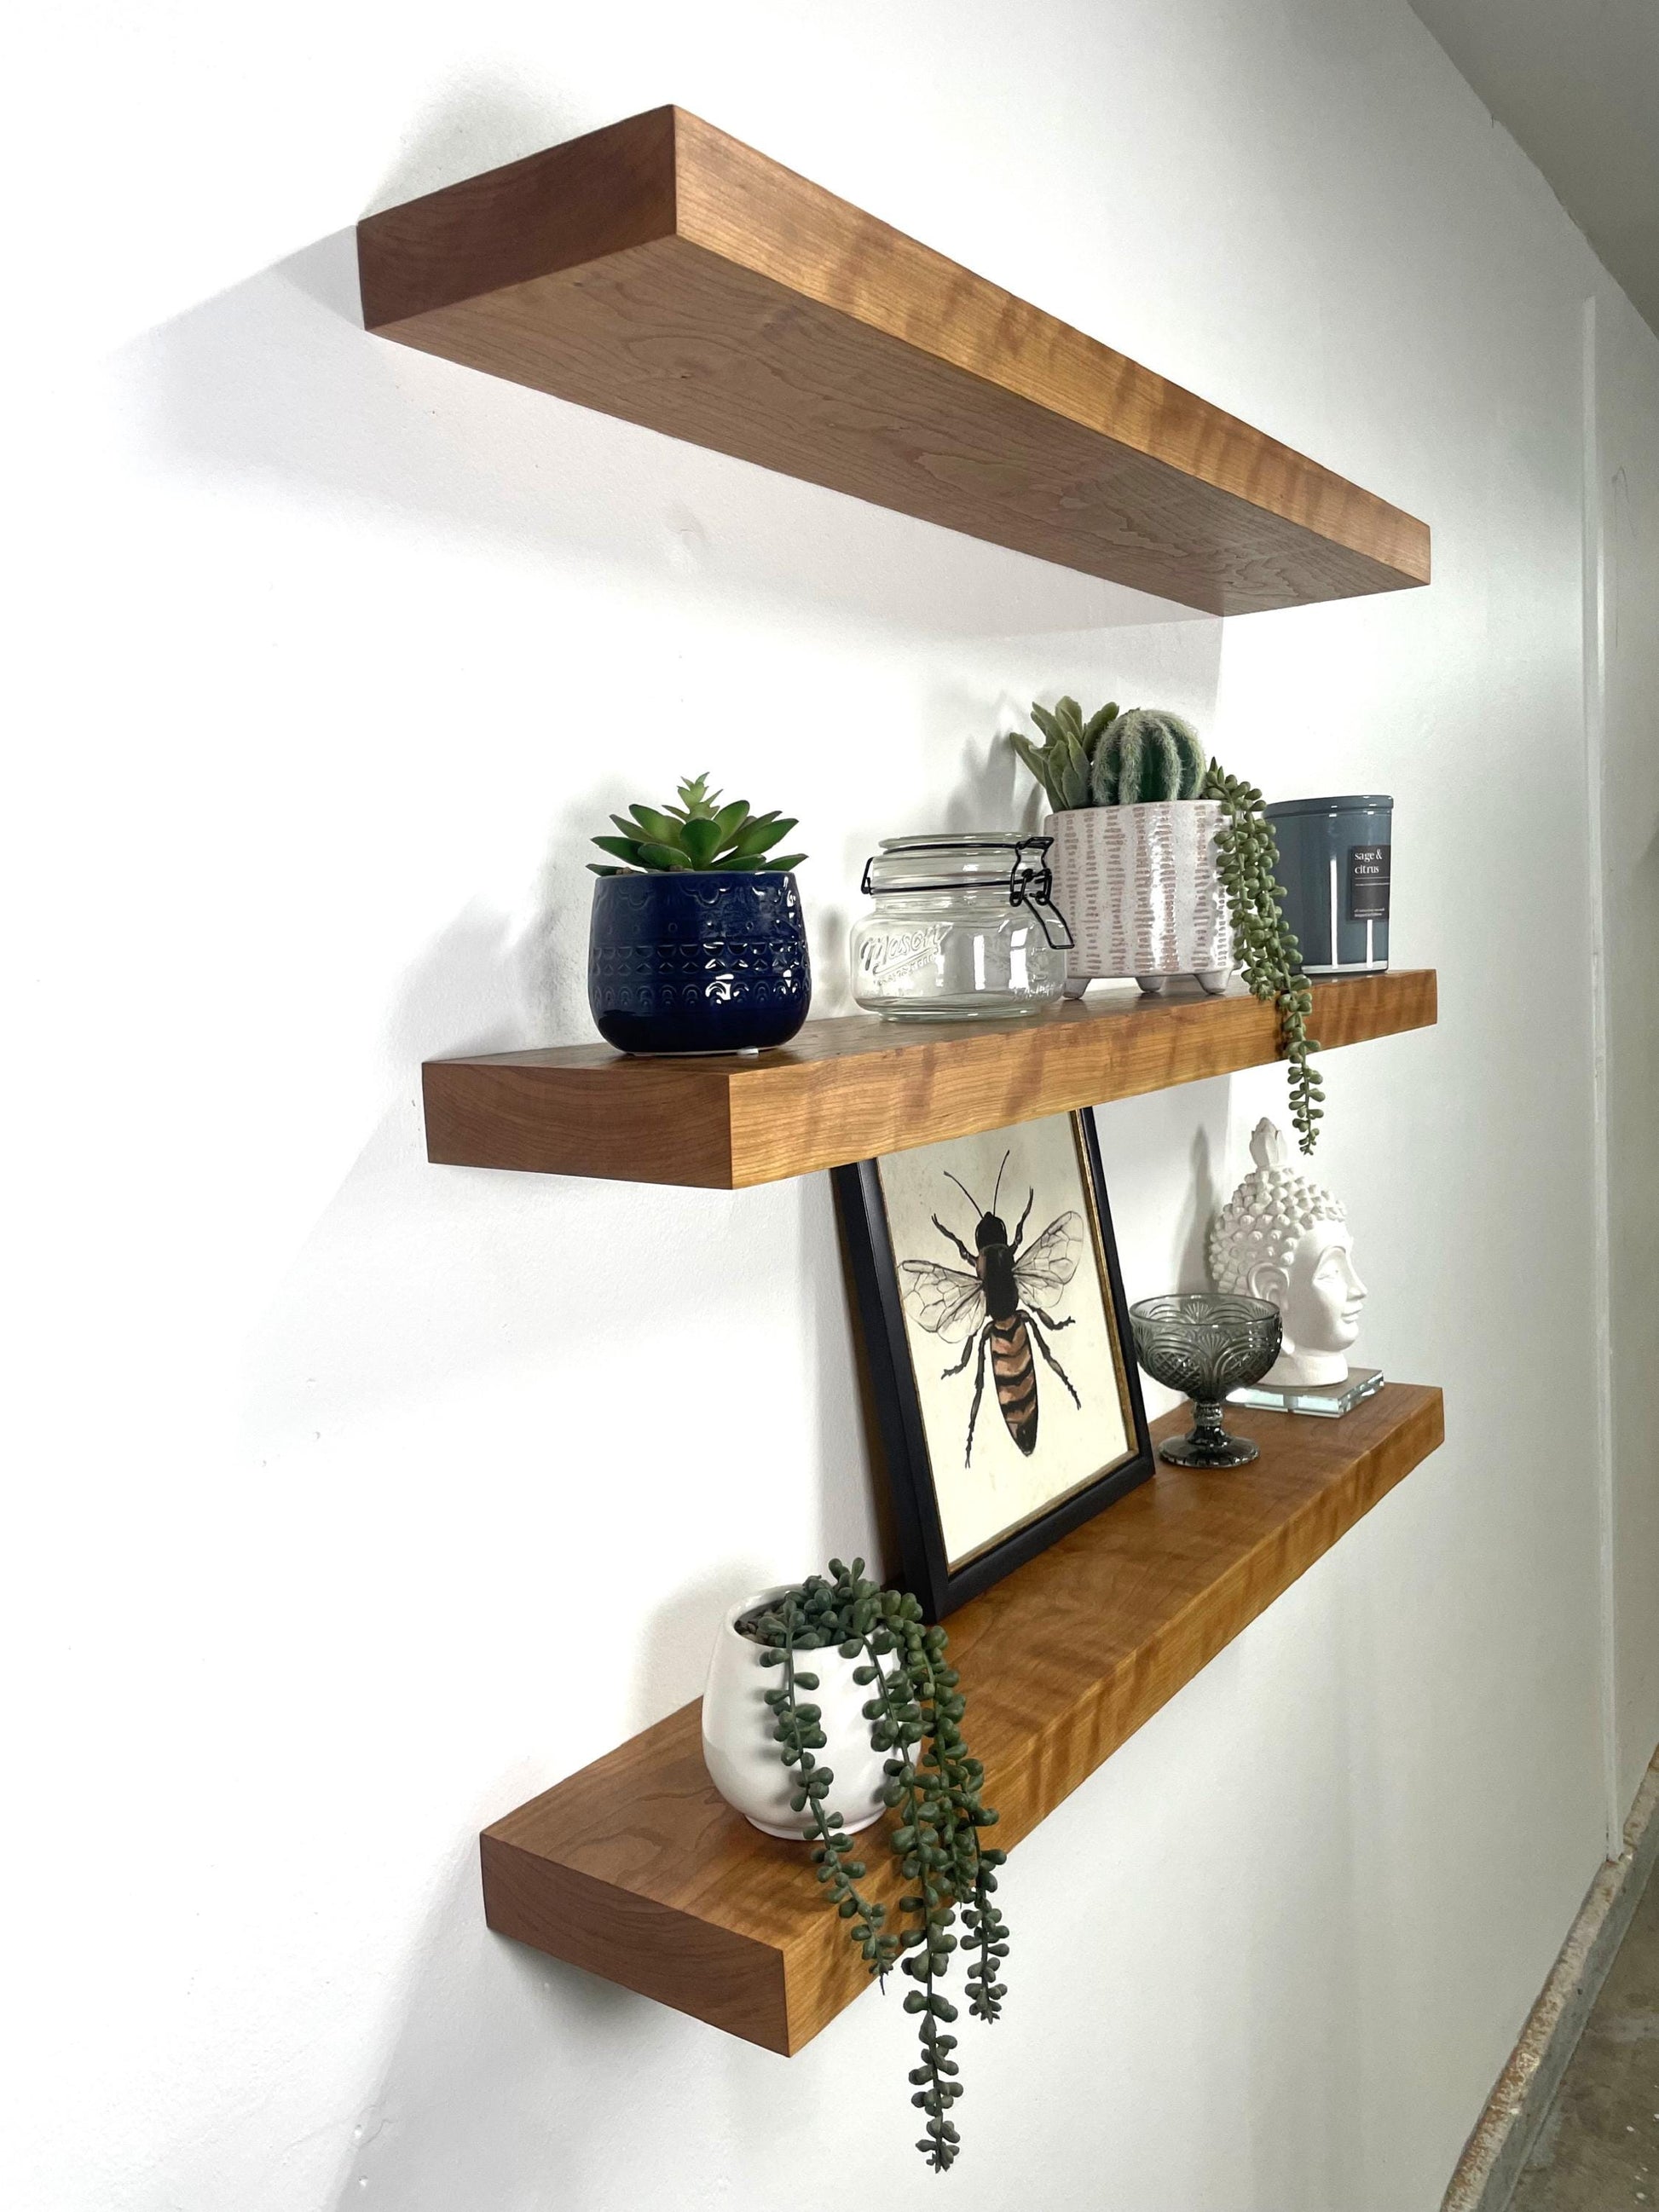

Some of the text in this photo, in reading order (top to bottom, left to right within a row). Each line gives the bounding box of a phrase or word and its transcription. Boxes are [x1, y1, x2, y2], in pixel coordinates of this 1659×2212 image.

[1355, 852, 1374, 863] sage
[1355, 864, 1379, 874] citrus
[860, 925, 951, 972] Mason
